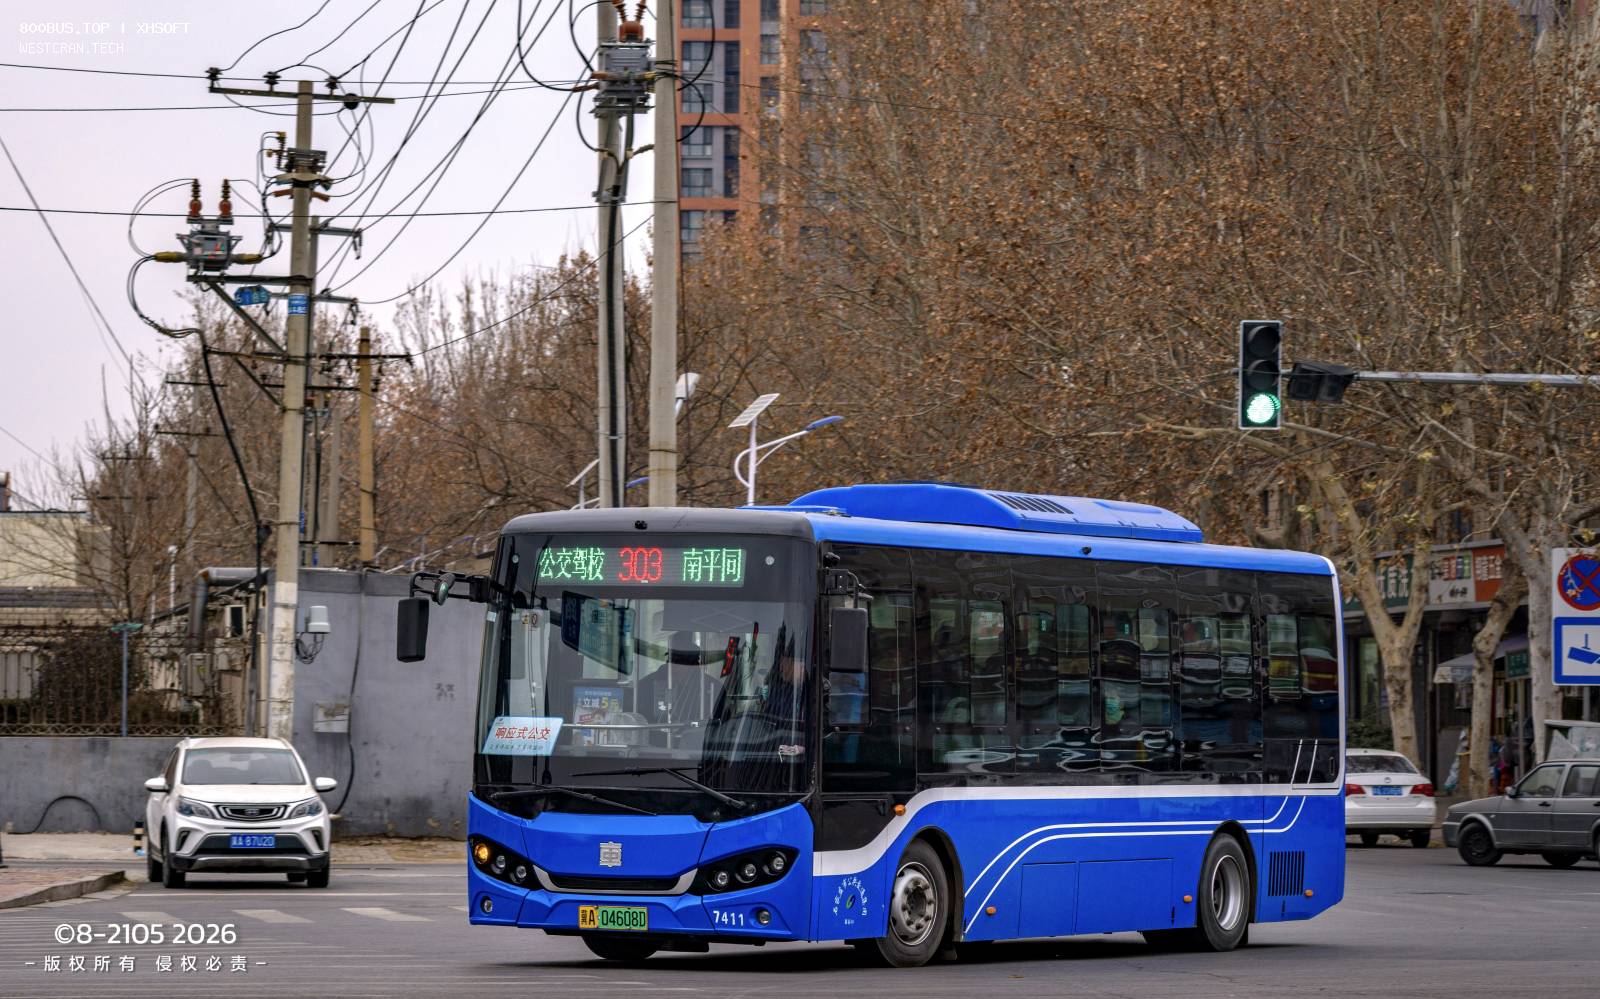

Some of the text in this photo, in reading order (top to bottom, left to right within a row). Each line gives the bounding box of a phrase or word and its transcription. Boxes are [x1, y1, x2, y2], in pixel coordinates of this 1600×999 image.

[540, 546, 742, 582] 公交驾校 303 南平同
[495, 726, 551, 741] 响应式公交
[601, 909, 646, 927] 04608D
[712, 910, 744, 927] 7411
